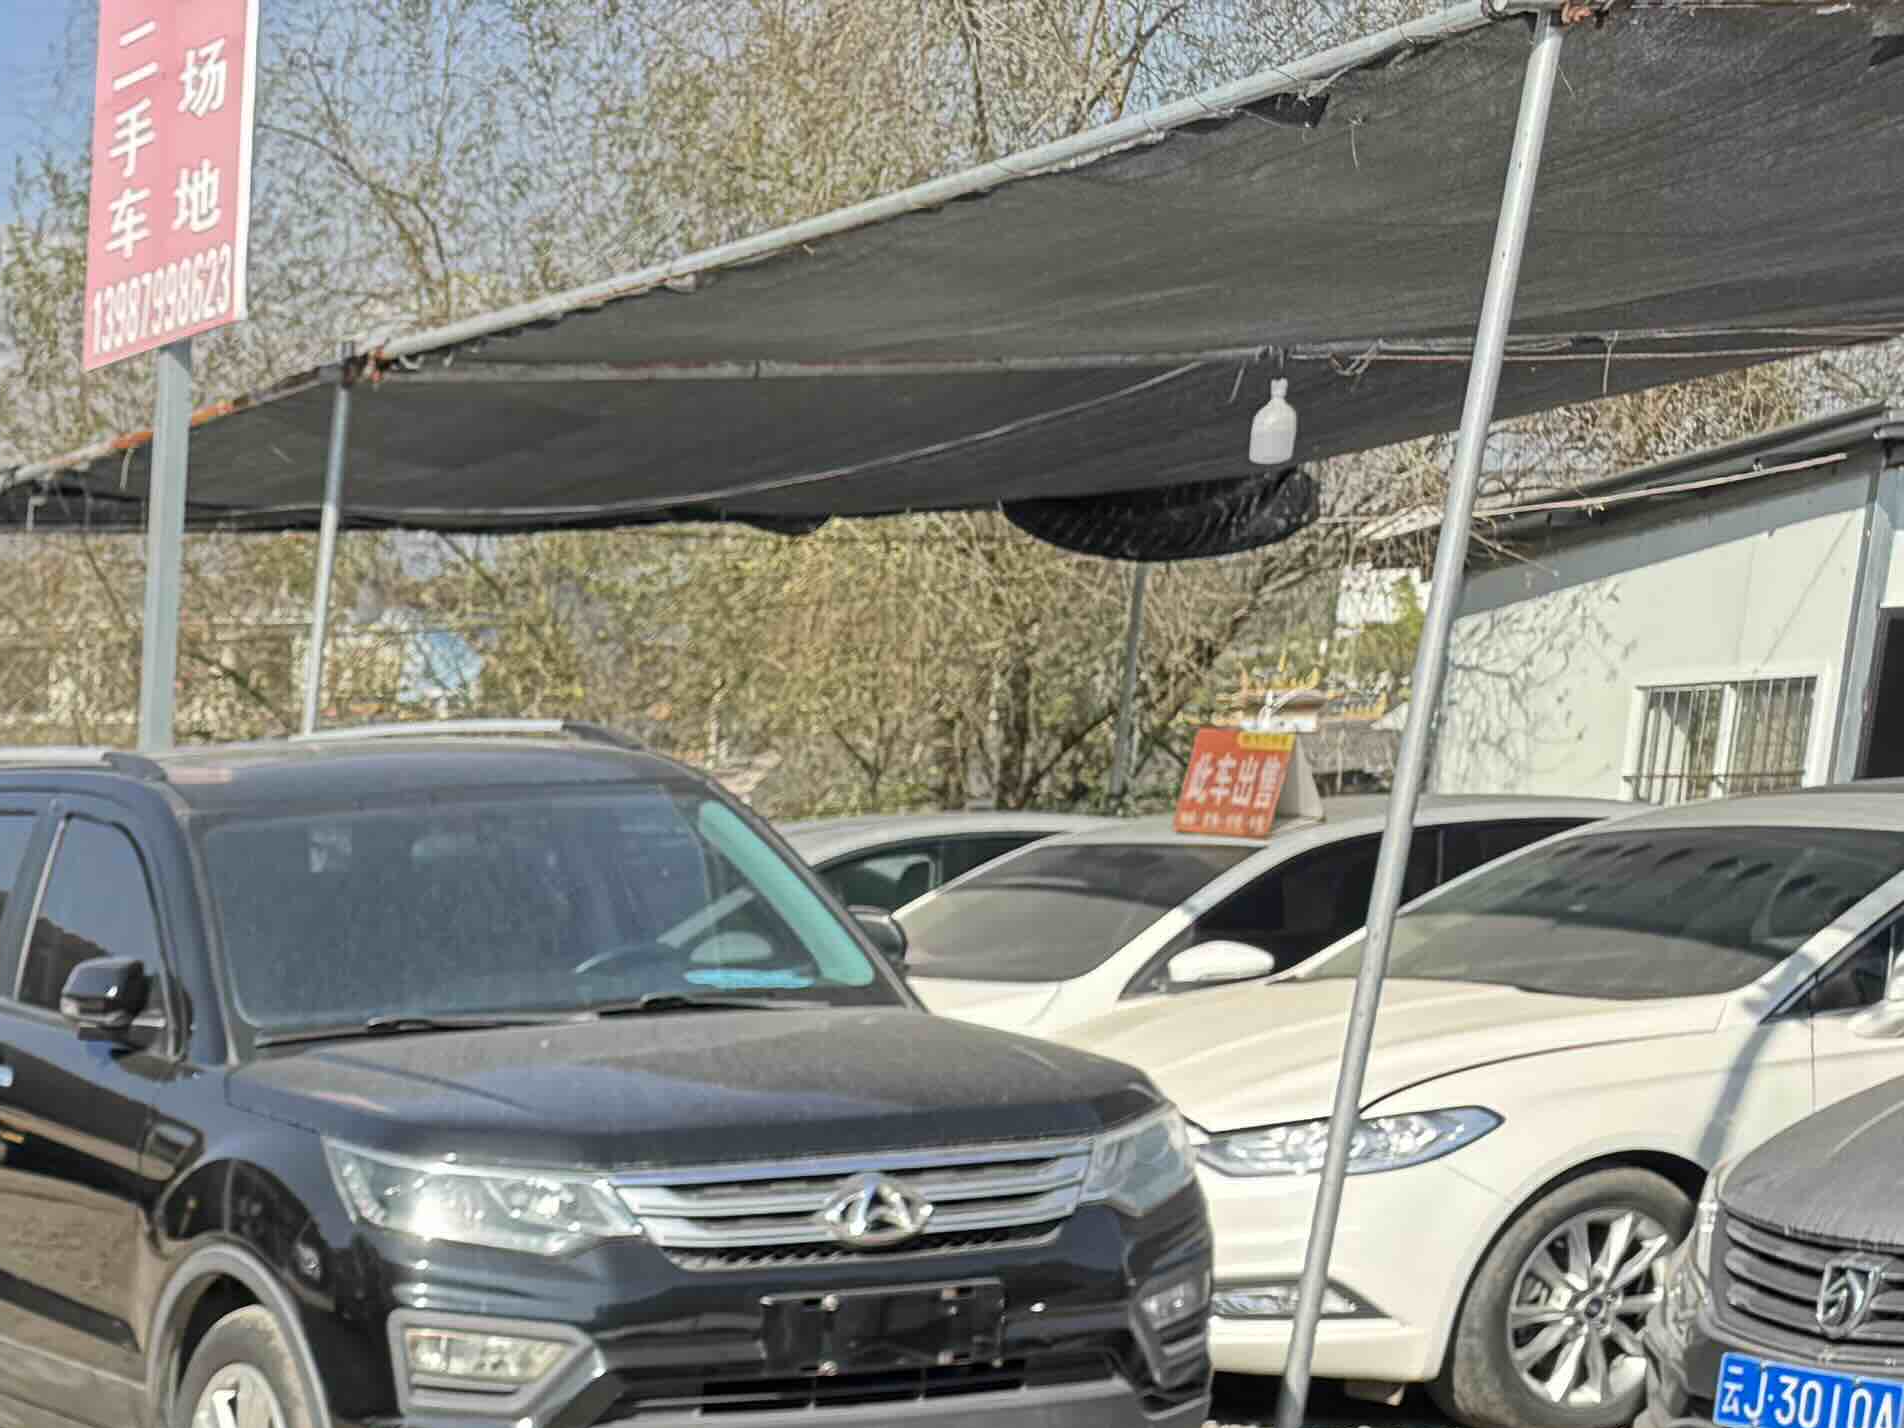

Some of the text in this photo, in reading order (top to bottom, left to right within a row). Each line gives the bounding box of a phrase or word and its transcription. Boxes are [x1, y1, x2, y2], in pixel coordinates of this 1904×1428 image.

[105, 20, 159, 259] 二手车
[172, 37, 227, 233] 场地
[1185, 752, 1282, 809] 此车出售
